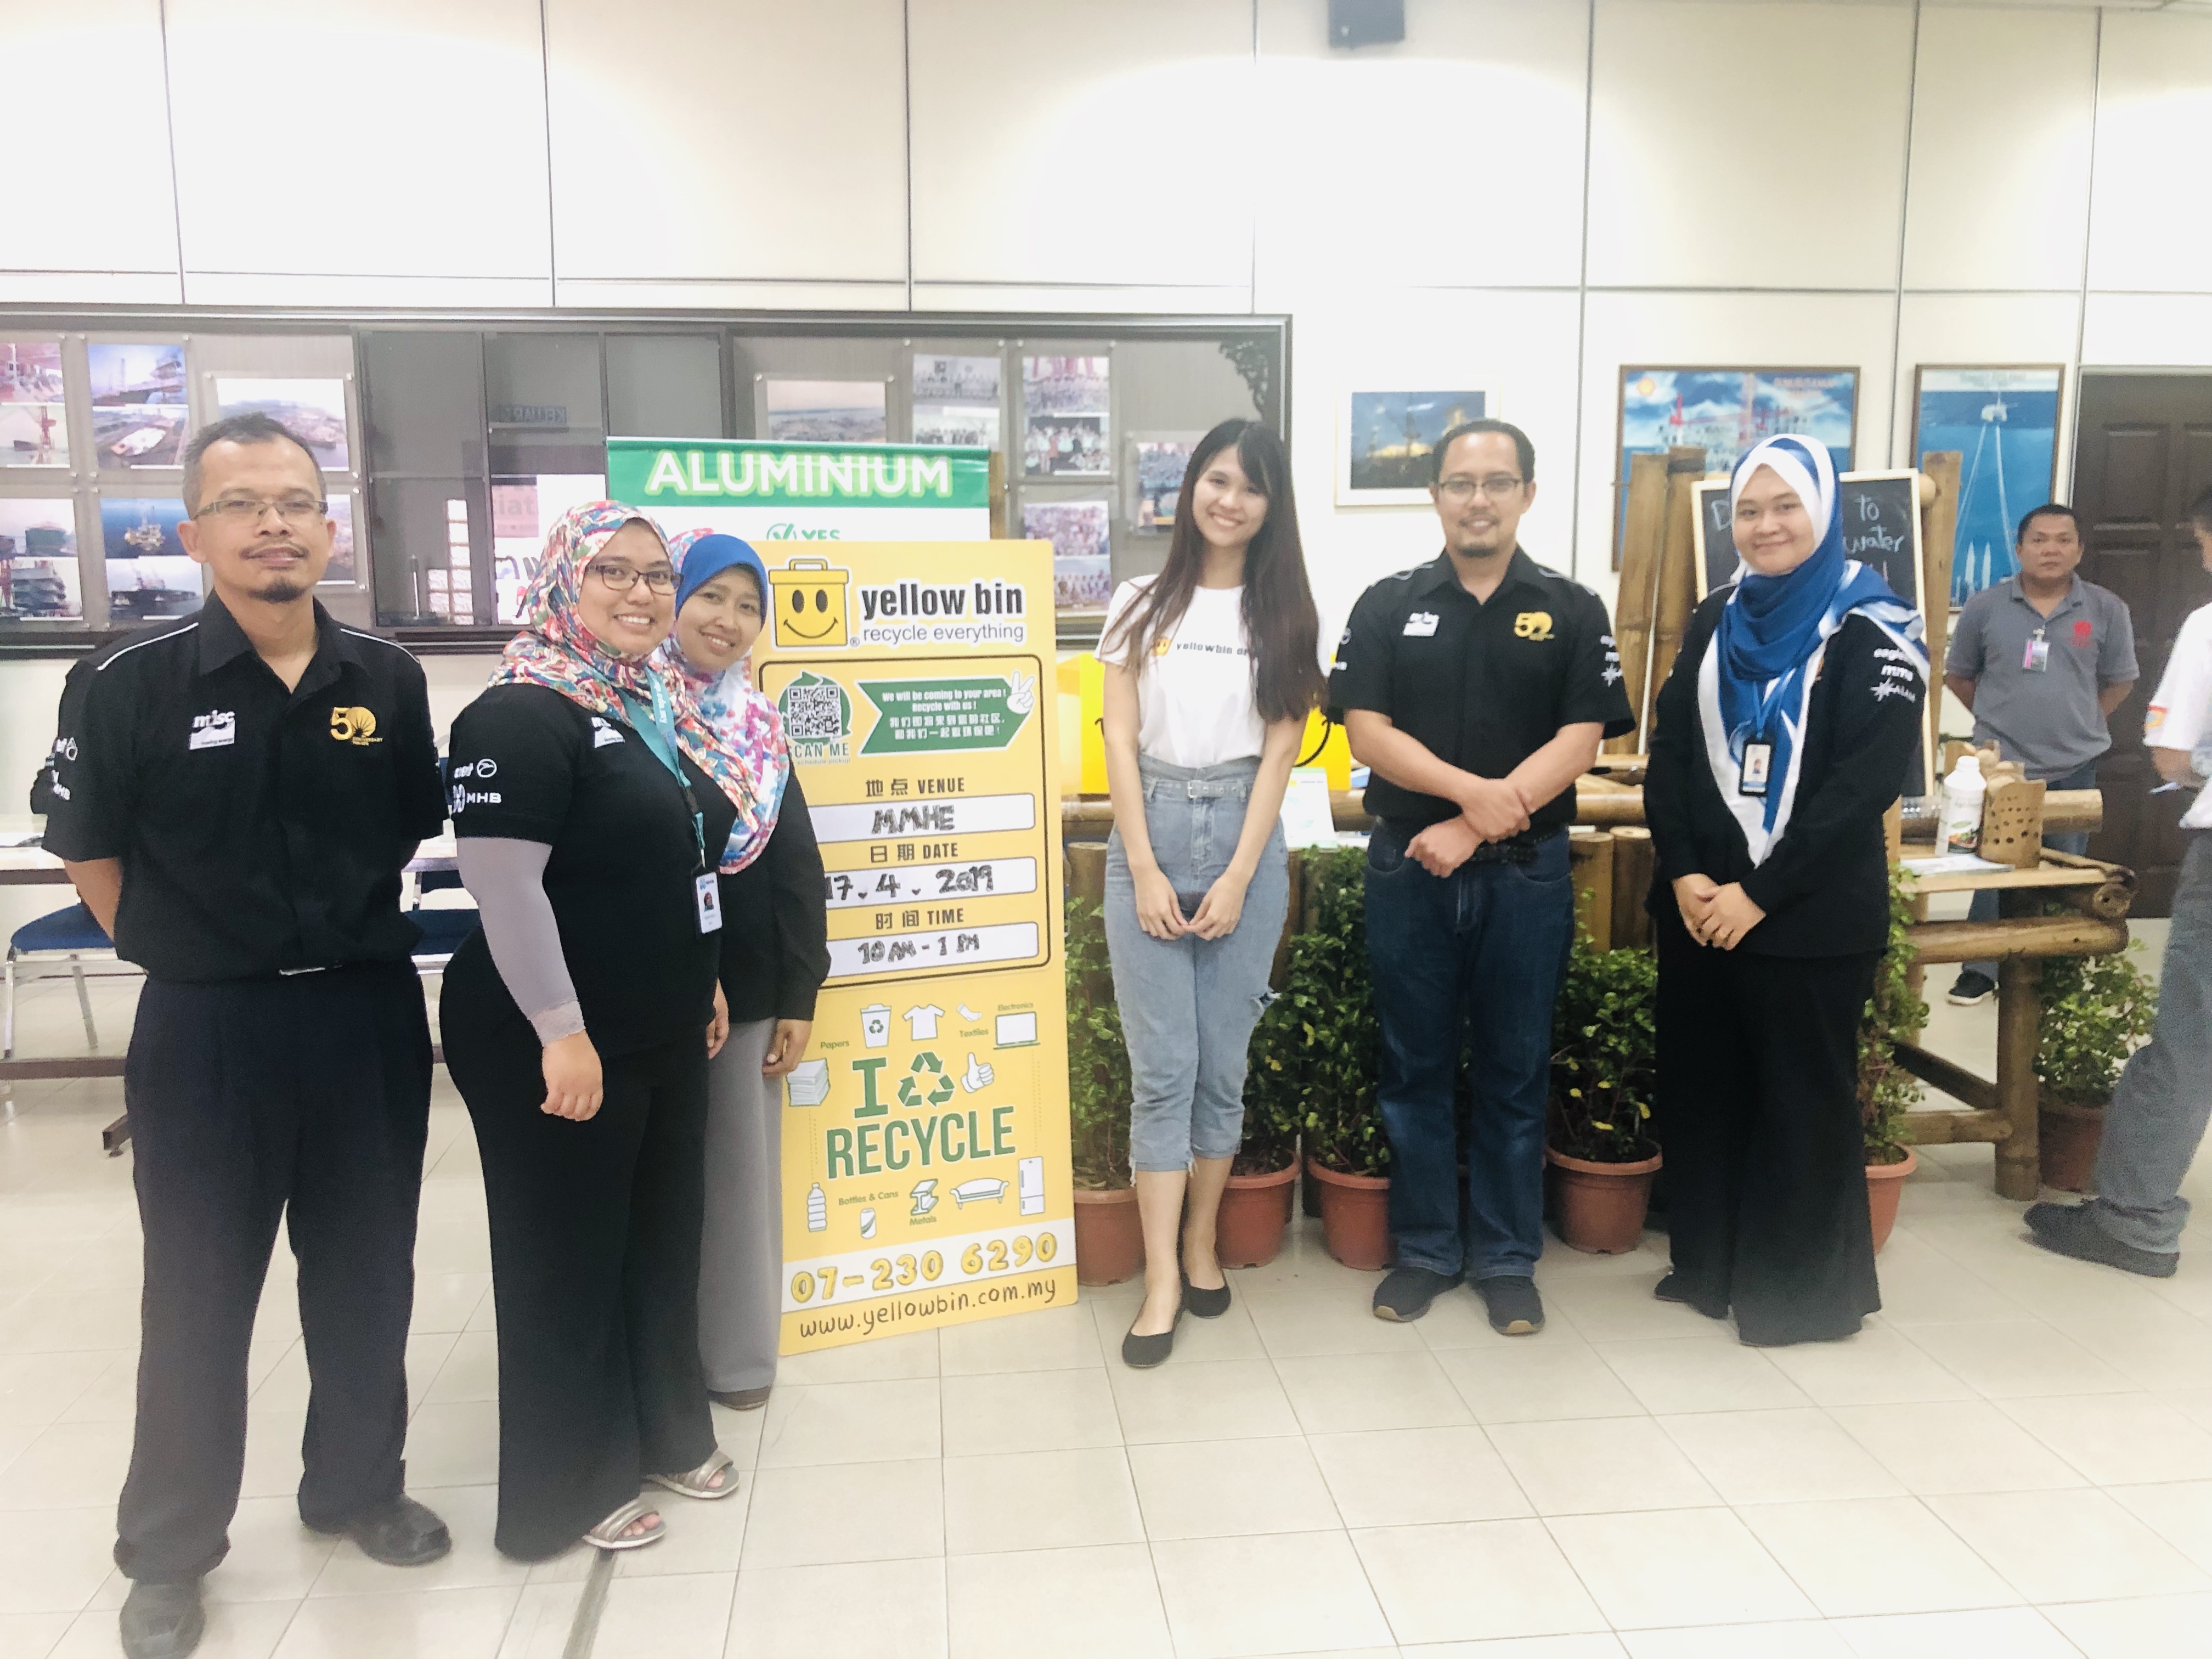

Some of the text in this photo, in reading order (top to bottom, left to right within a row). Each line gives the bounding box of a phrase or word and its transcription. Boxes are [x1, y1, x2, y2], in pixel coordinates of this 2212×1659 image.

[650, 451, 949, 494] ALUMINIUM
[861, 583, 1023, 620] yellow bin
[863, 624, 1024, 646] recycle everything
[882, 692, 895, 702] We
[896, 691, 911, 701] will
[912, 690, 923, 701] be
[924, 689, 953, 701] coming
[955, 690, 962, 699] to
[963, 689, 982, 699] your
[912, 702, 943, 713] Recycle
[944, 701, 961, 711] with
[830, 742, 849, 757] ME
[866, 777, 966, 797] 地点 VENUE
[466, 792, 502, 804] MHB
[871, 805, 956, 834] MMHE
[870, 842, 958, 864] 日期 DATE
[875, 907, 964, 930] 时间 TIME
[996, 1002, 1035, 1012] Electronics
[959, 1028, 989, 1039] Textiles
[820, 1040, 850, 1051] Papers
[852, 1057, 889, 1119] I
[827, 1105, 1017, 1180] RECYCLE
[838, 1189, 899, 1206] Bottles & Cans
[909, 1214, 938, 1227] Metals
[791, 1232, 1058, 1304] 07-230 6290
[800, 1277, 1057, 1339] www.yellowbin.com.my
